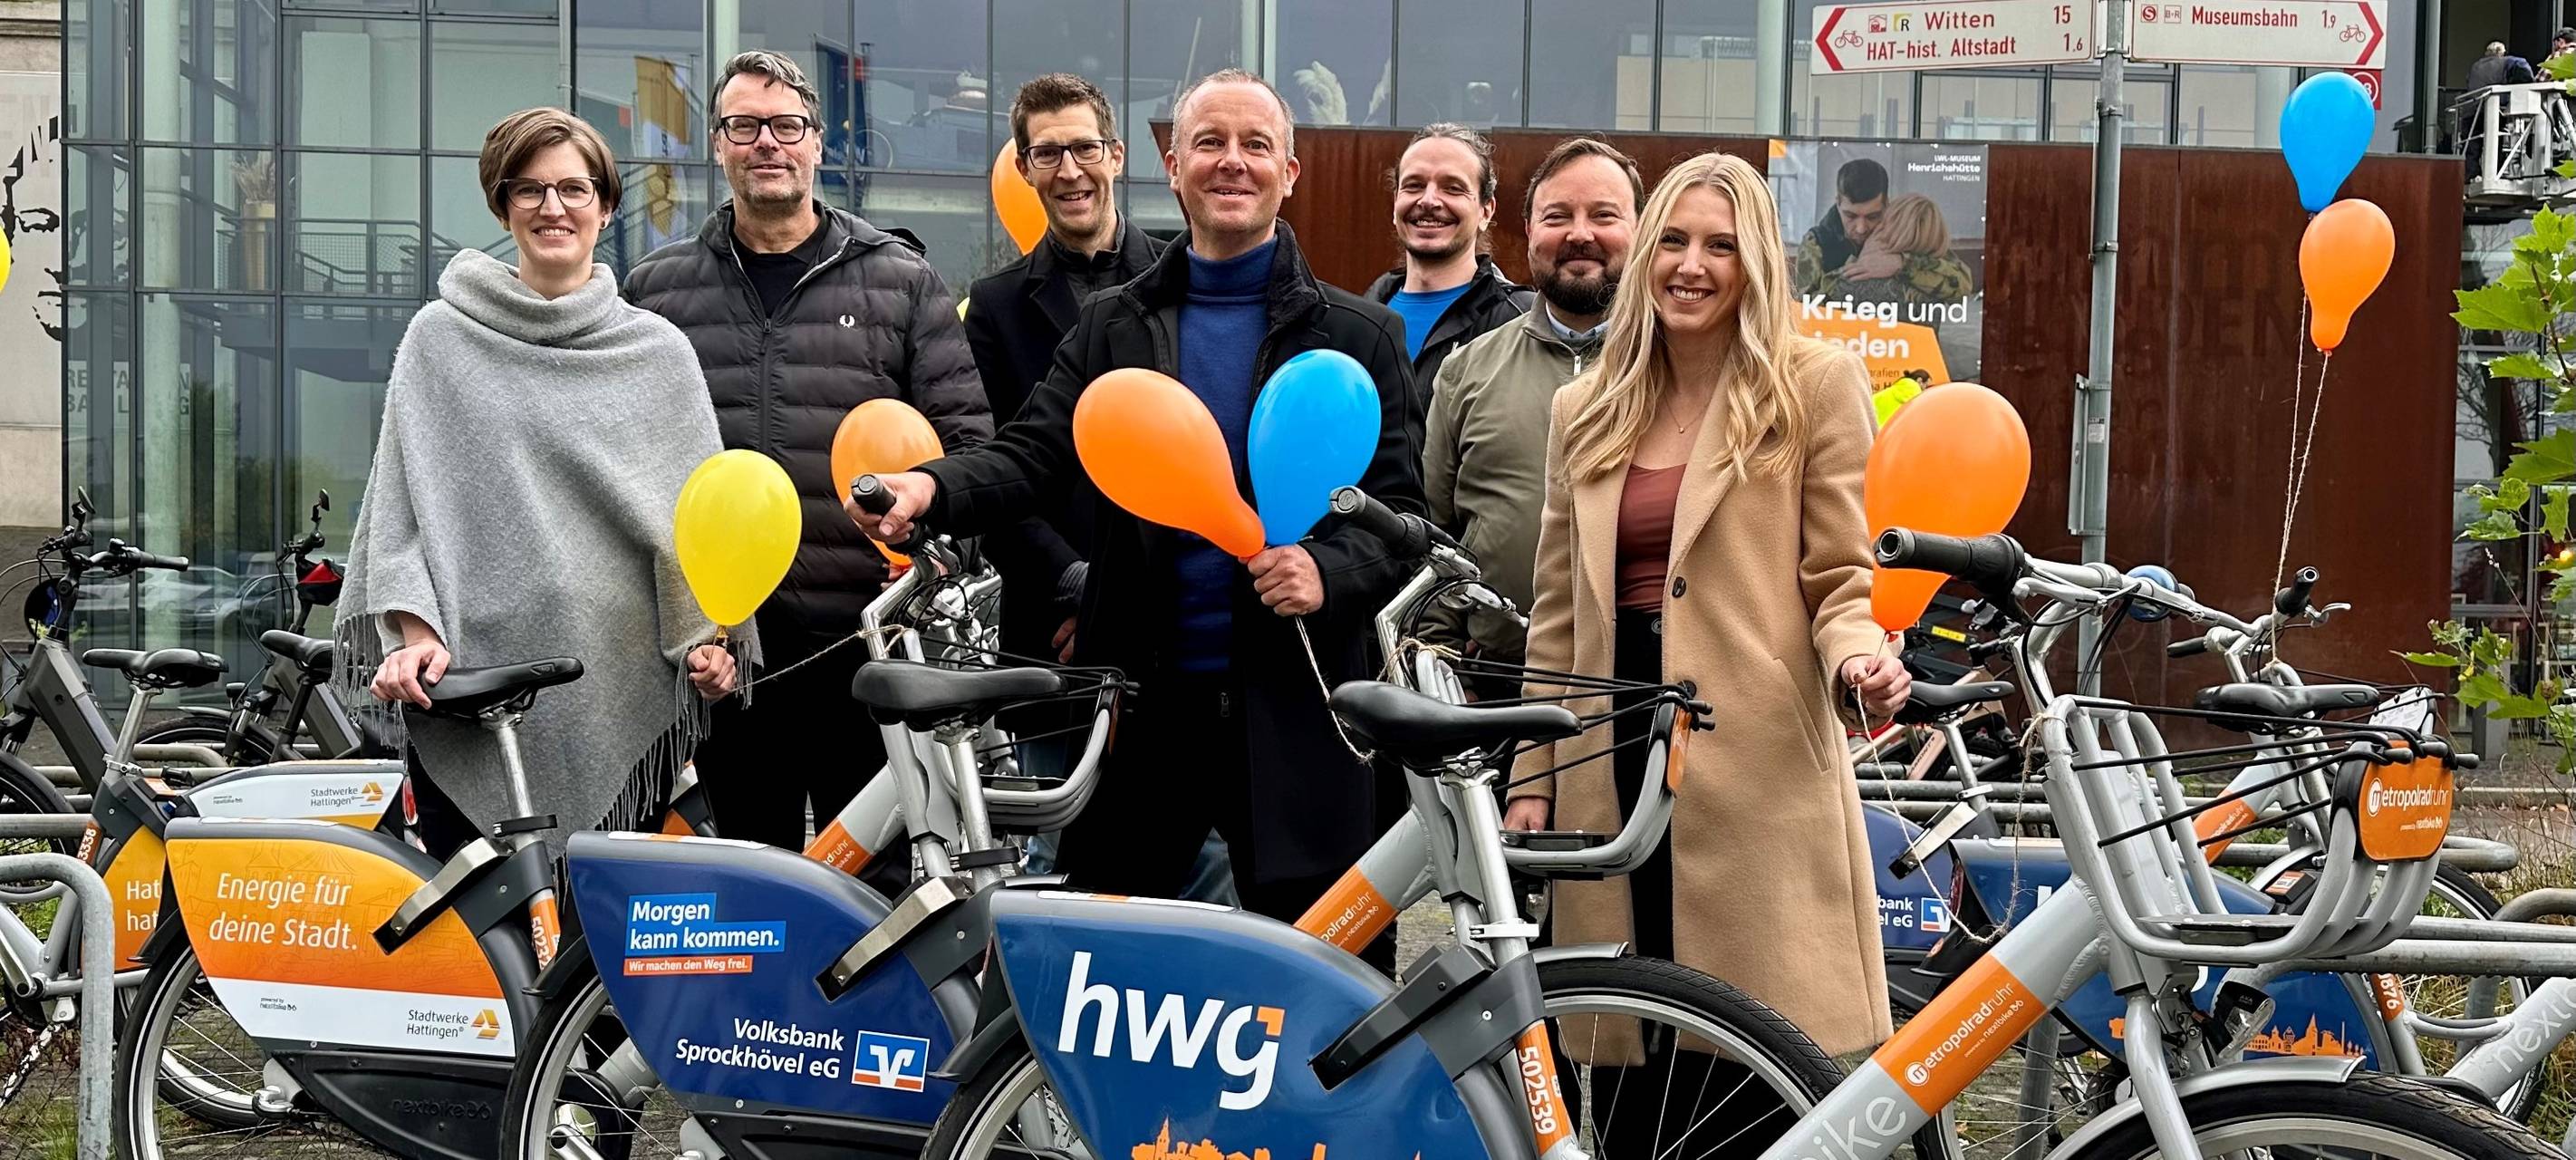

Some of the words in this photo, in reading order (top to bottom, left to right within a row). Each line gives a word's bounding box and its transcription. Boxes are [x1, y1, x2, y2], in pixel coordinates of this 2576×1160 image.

[1925, 12, 1995, 31] Witten
[2054, 5, 2071, 24] 15
[2192, 6, 2298, 27] Museumsbahn
[1867, 40, 1941, 61] HAT-hist.
[1951, 36, 2016, 57] Altstadt
[1907, 162, 1981, 173] Henrichshütte
[1943, 174, 1980, 182] HATTINGEN
[1801, 294, 1898, 328] Krieg
[1907, 295, 1968, 324] und
[311, 786, 359, 798] Stadtwerke
[216, 872, 306, 910] Energie
[313, 875, 352, 907] für
[632, 901, 709, 925] Morgen
[1893, 914, 1914, 929] eG
[208, 911, 275, 945] deine
[281, 917, 358, 952] Stadt.
[630, 928, 678, 951] kann
[682, 926, 780, 949] kommen.
[629, 961, 645, 972] Wir
[646, 959, 681, 972] machen
[683, 958, 702, 971] den
[704, 958, 726, 972] Weg
[727, 957, 748, 970] frei.
[408, 1009, 469, 1025] Stadtwerke
[1983, 1010, 2014, 1039] nextbike
[734, 1017, 844, 1051] Volksbank
[1057, 950, 1286, 1111] hwg
[1905, 982, 2014, 1088] metropolradruhr
[675, 1038, 805, 1075] Sprockhövel
[808, 1057, 841, 1079] eG
[1518, 1045, 1558, 1136] 502539
[1801, 1096, 1906, 1160] ike
